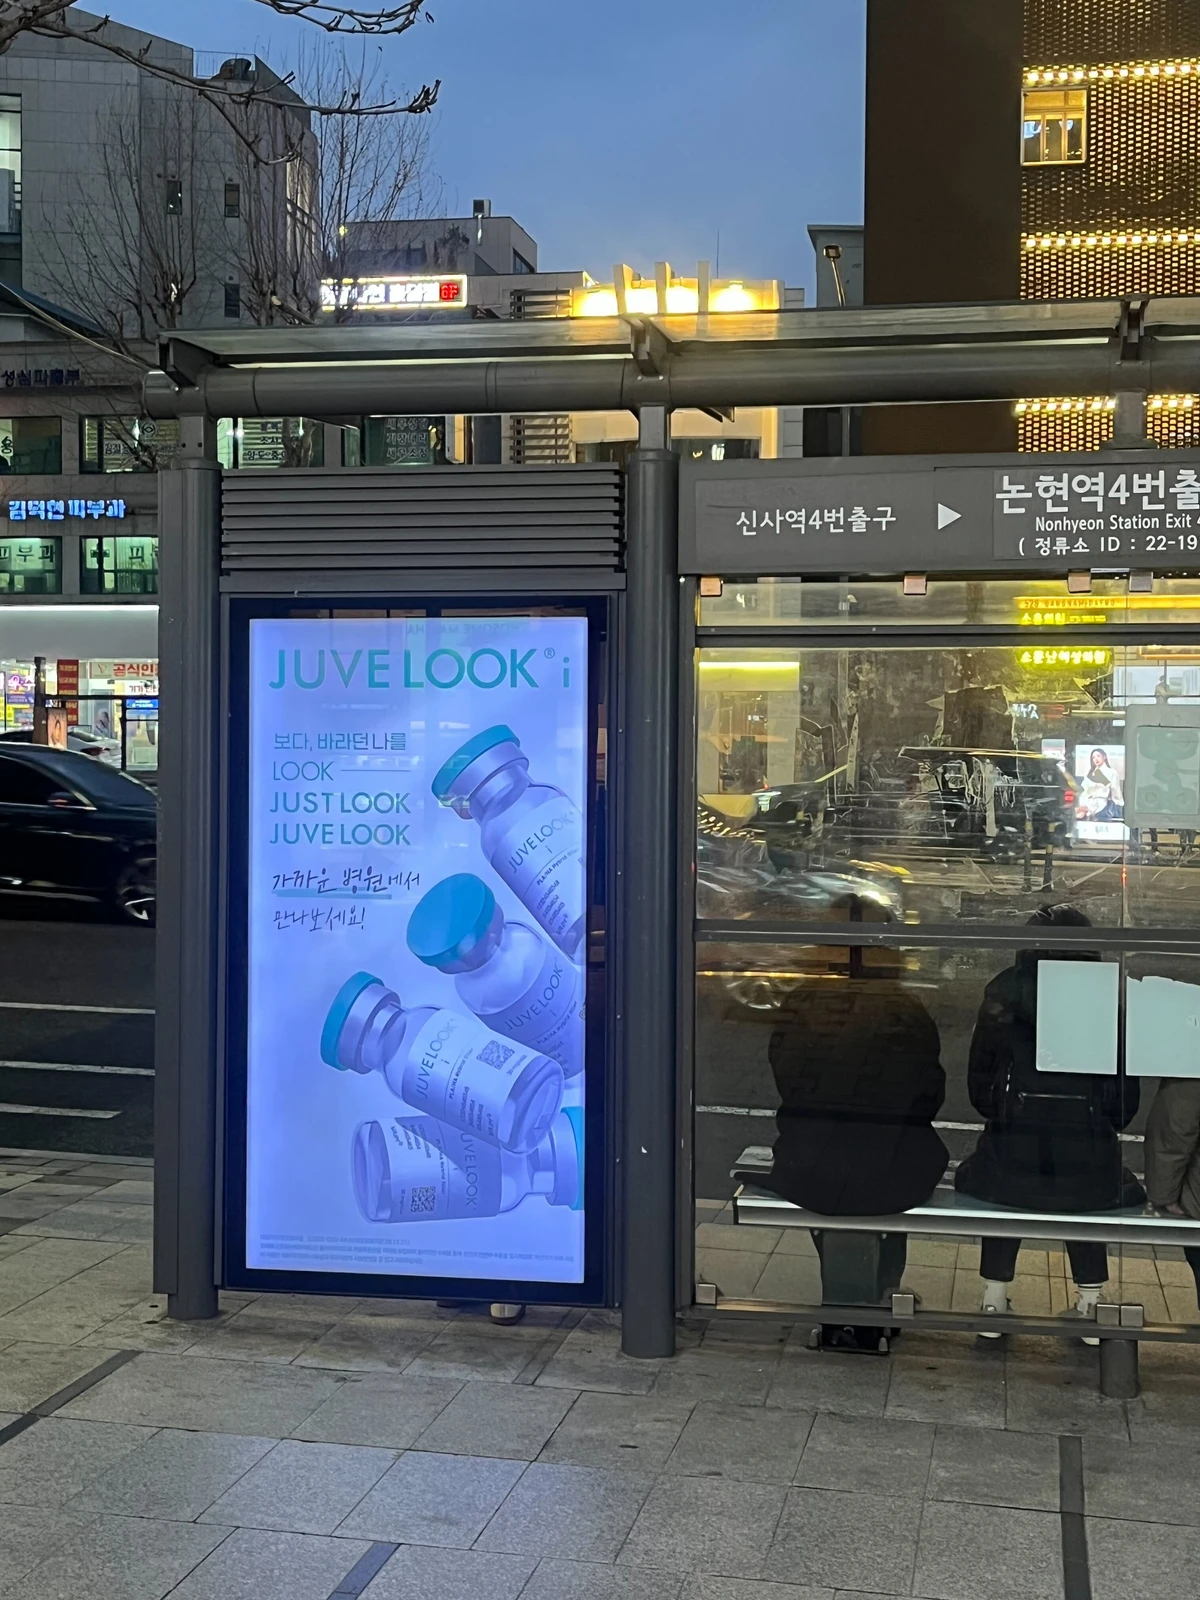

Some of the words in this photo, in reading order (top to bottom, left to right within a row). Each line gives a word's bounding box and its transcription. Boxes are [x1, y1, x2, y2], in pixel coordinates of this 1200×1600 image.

[995, 469, 1200, 514] 논현역4번출
[68, 499, 126, 520] 피부과
[736, 506, 897, 536] 신사역4번출구
[1035, 516, 1104, 533] Nonhyeon
[1109, 513, 1160, 530] Station
[1165, 513, 1192, 529] Exit
[1034, 536, 1090, 556] 정류소
[1100, 536, 1120, 552] ID
[1145, 534, 1200, 551] 22-19
[113, 663, 158, 677] 공식인
[562, 656, 571, 689] i
[274, 732, 313, 752] 보다,
[317, 732, 369, 750] 바라던
[372, 732, 407, 750] 나를
[273, 761, 335, 781] LOOK
[269, 791, 334, 814] JUST
[340, 791, 412, 814] LOOK
[272, 867, 338, 894] 가까운
[342, 865, 420, 894] 병원에서
[273, 904, 366, 932] 만나보세요!
